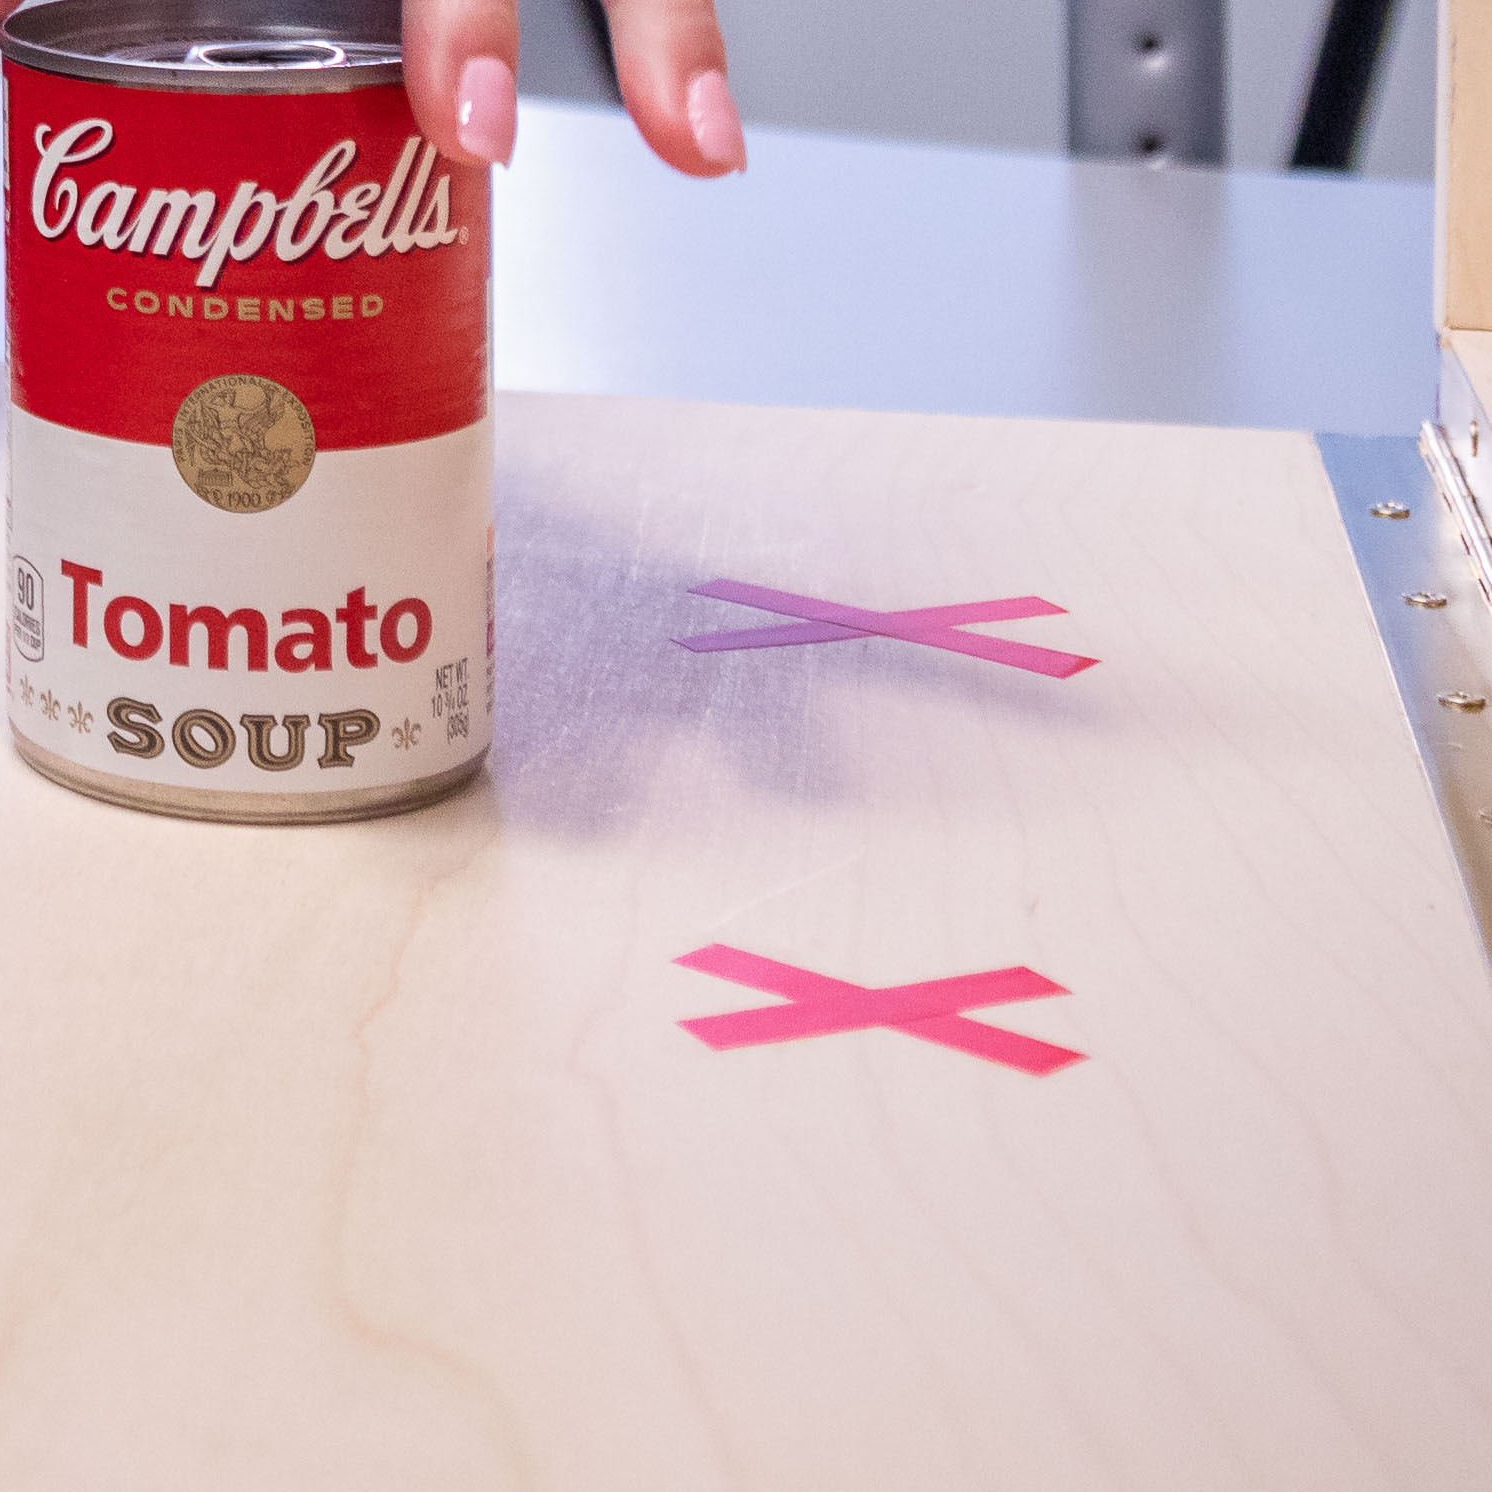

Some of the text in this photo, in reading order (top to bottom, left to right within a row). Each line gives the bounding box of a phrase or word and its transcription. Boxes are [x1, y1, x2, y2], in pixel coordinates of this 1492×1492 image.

[106, 287, 384, 321] CONDENSED
[177, 376, 262, 422] INTERNATIONAL
[283, 388, 314, 466] EXPOSITION
[227, 491, 261, 508] 1900
[17, 567, 35, 611] 90
[61, 559, 433, 672] Tomato
[435, 663, 453, 690] NET
[431, 693, 443, 718] 10
[106, 696, 381, 772] SOUP
